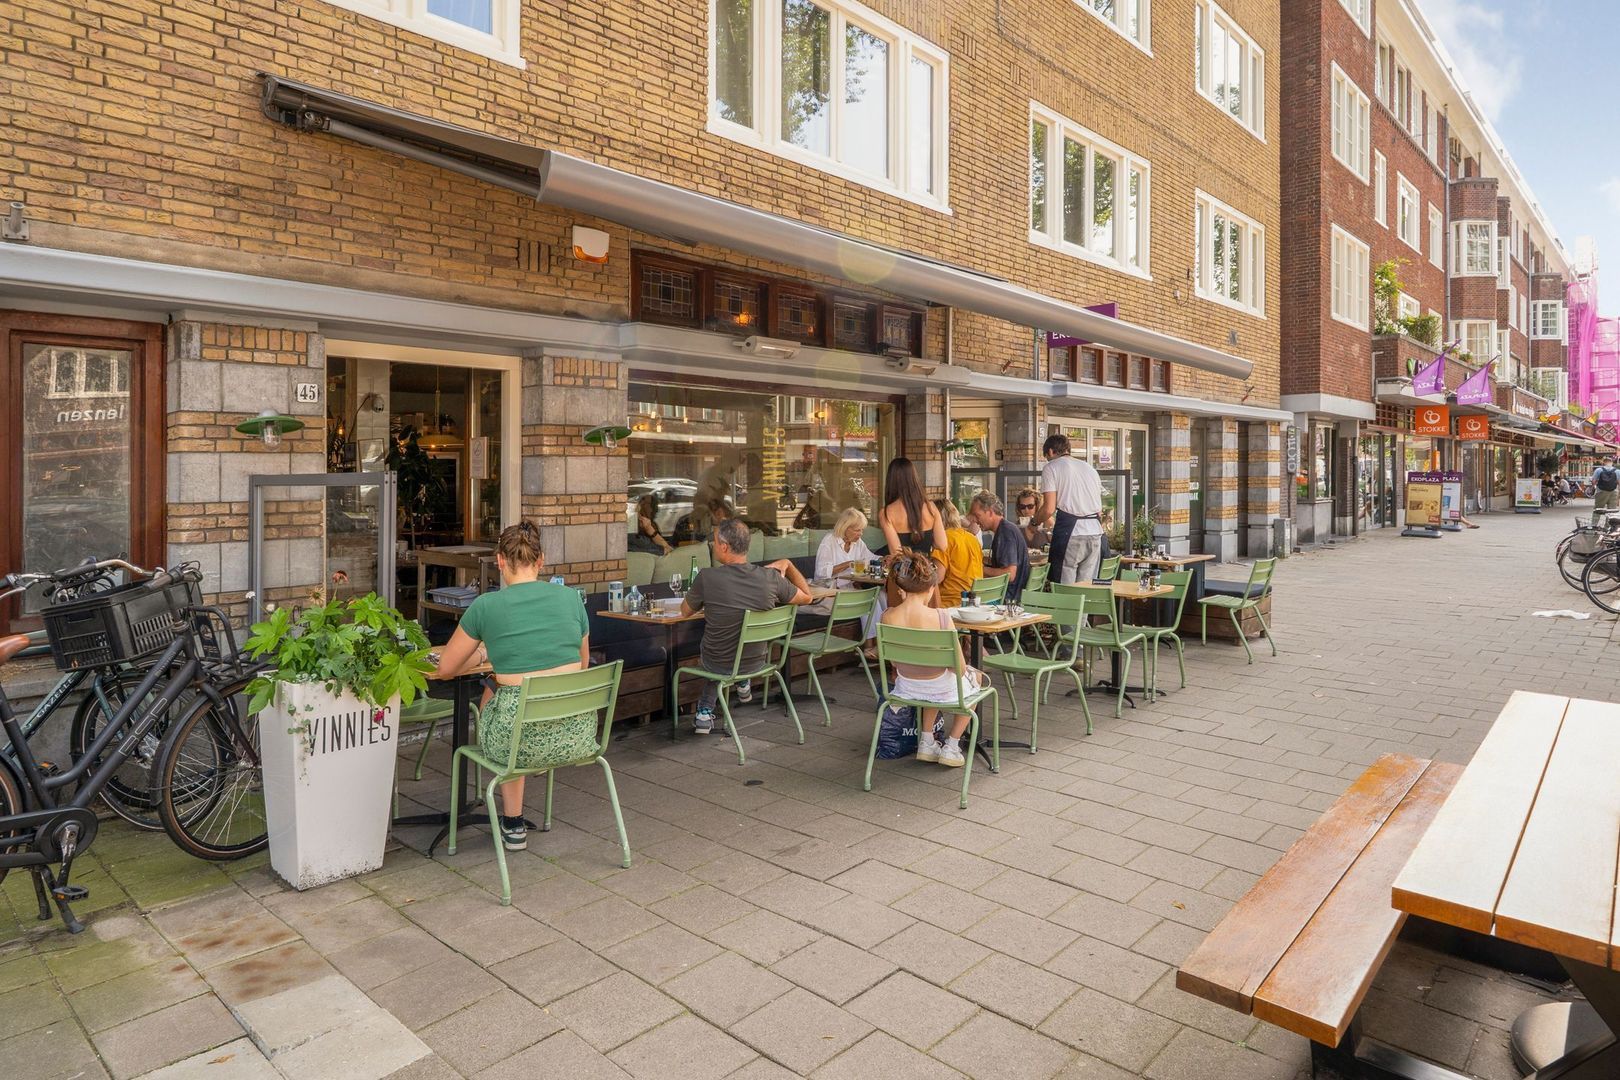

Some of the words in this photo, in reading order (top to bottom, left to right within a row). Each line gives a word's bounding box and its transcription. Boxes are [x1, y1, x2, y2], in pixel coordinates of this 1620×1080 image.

[300, 385, 316, 400] 45
[762, 427, 785, 500] VINNIES
[118, 697, 168, 757] BSP
[307, 705, 391, 757] VINNIES
